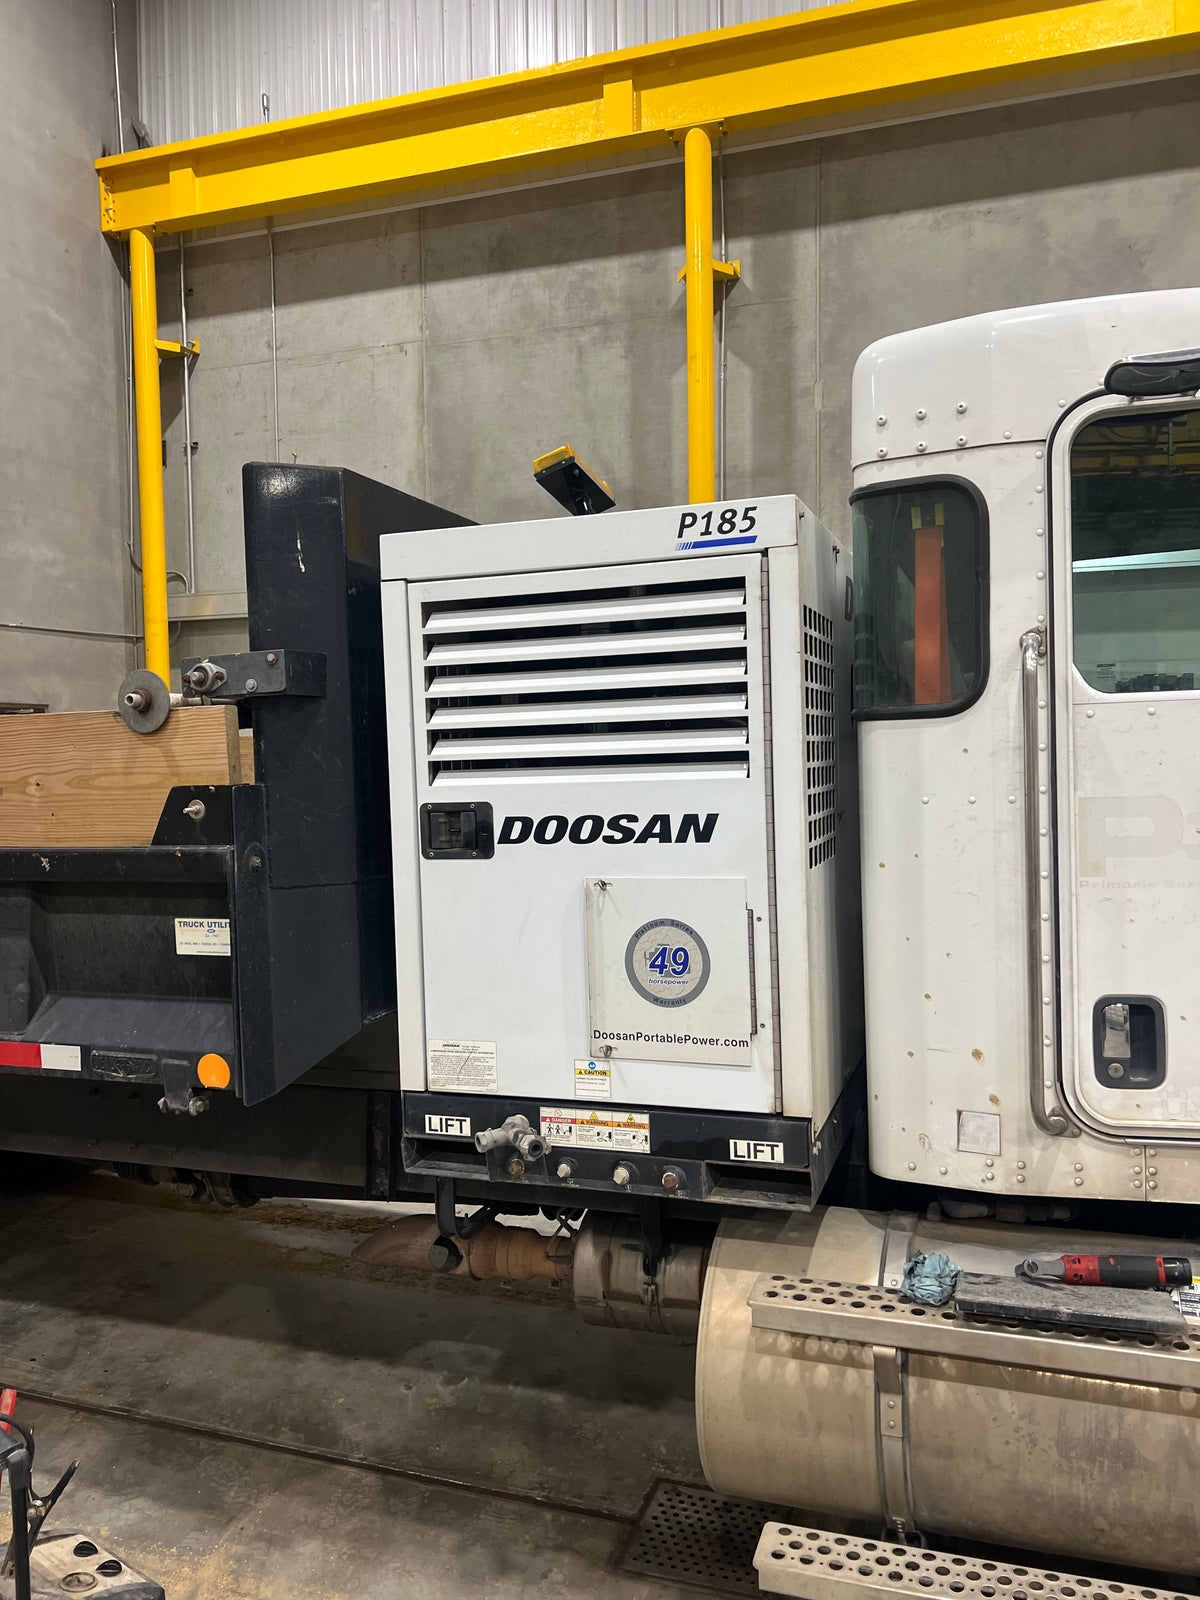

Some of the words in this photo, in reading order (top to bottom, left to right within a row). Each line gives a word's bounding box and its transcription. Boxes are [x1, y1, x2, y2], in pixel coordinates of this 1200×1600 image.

[678, 506, 758, 539] P185
[496, 812, 720, 845] DOOSAN
[178, 921, 205, 929] TRUCK
[634, 920, 665, 940] Platinum
[670, 920, 694, 935] Series
[648, 946, 690, 976] 49
[648, 978, 689, 986] horsepower
[653, 997, 687, 1006] Warranty
[593, 1029, 749, 1048] DoosanPortablePower.com
[428, 1117, 467, 1134] LIFT
[733, 1141, 780, 1161] LIFT
